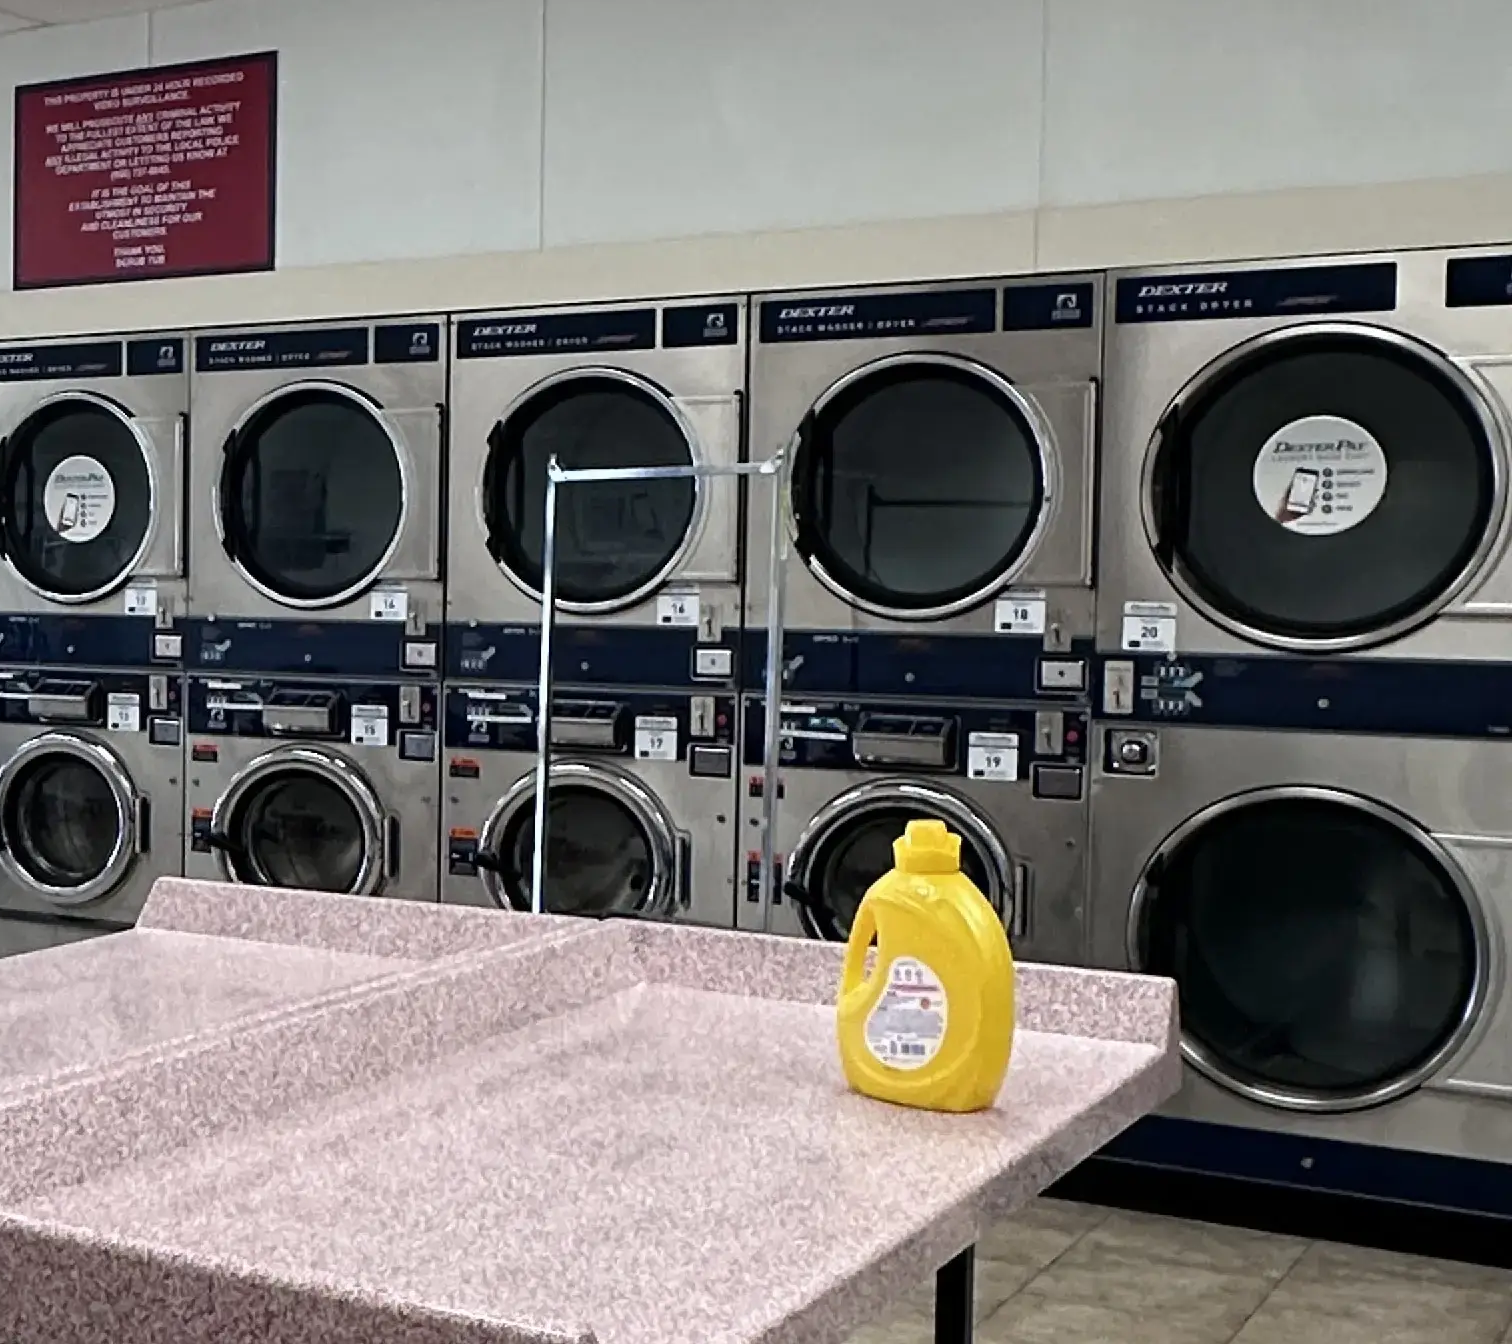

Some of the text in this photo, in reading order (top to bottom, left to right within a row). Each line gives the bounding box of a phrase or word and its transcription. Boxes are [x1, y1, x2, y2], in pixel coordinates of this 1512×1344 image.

[1138, 281, 1228, 298] DEXTER
[779, 305, 855, 319] DEXTER
[472, 324, 537, 337] DEXTER
[210, 340, 266, 352] DEXTER
[1141, 626, 1158, 638] 20
[985, 756, 1001, 768] 19
